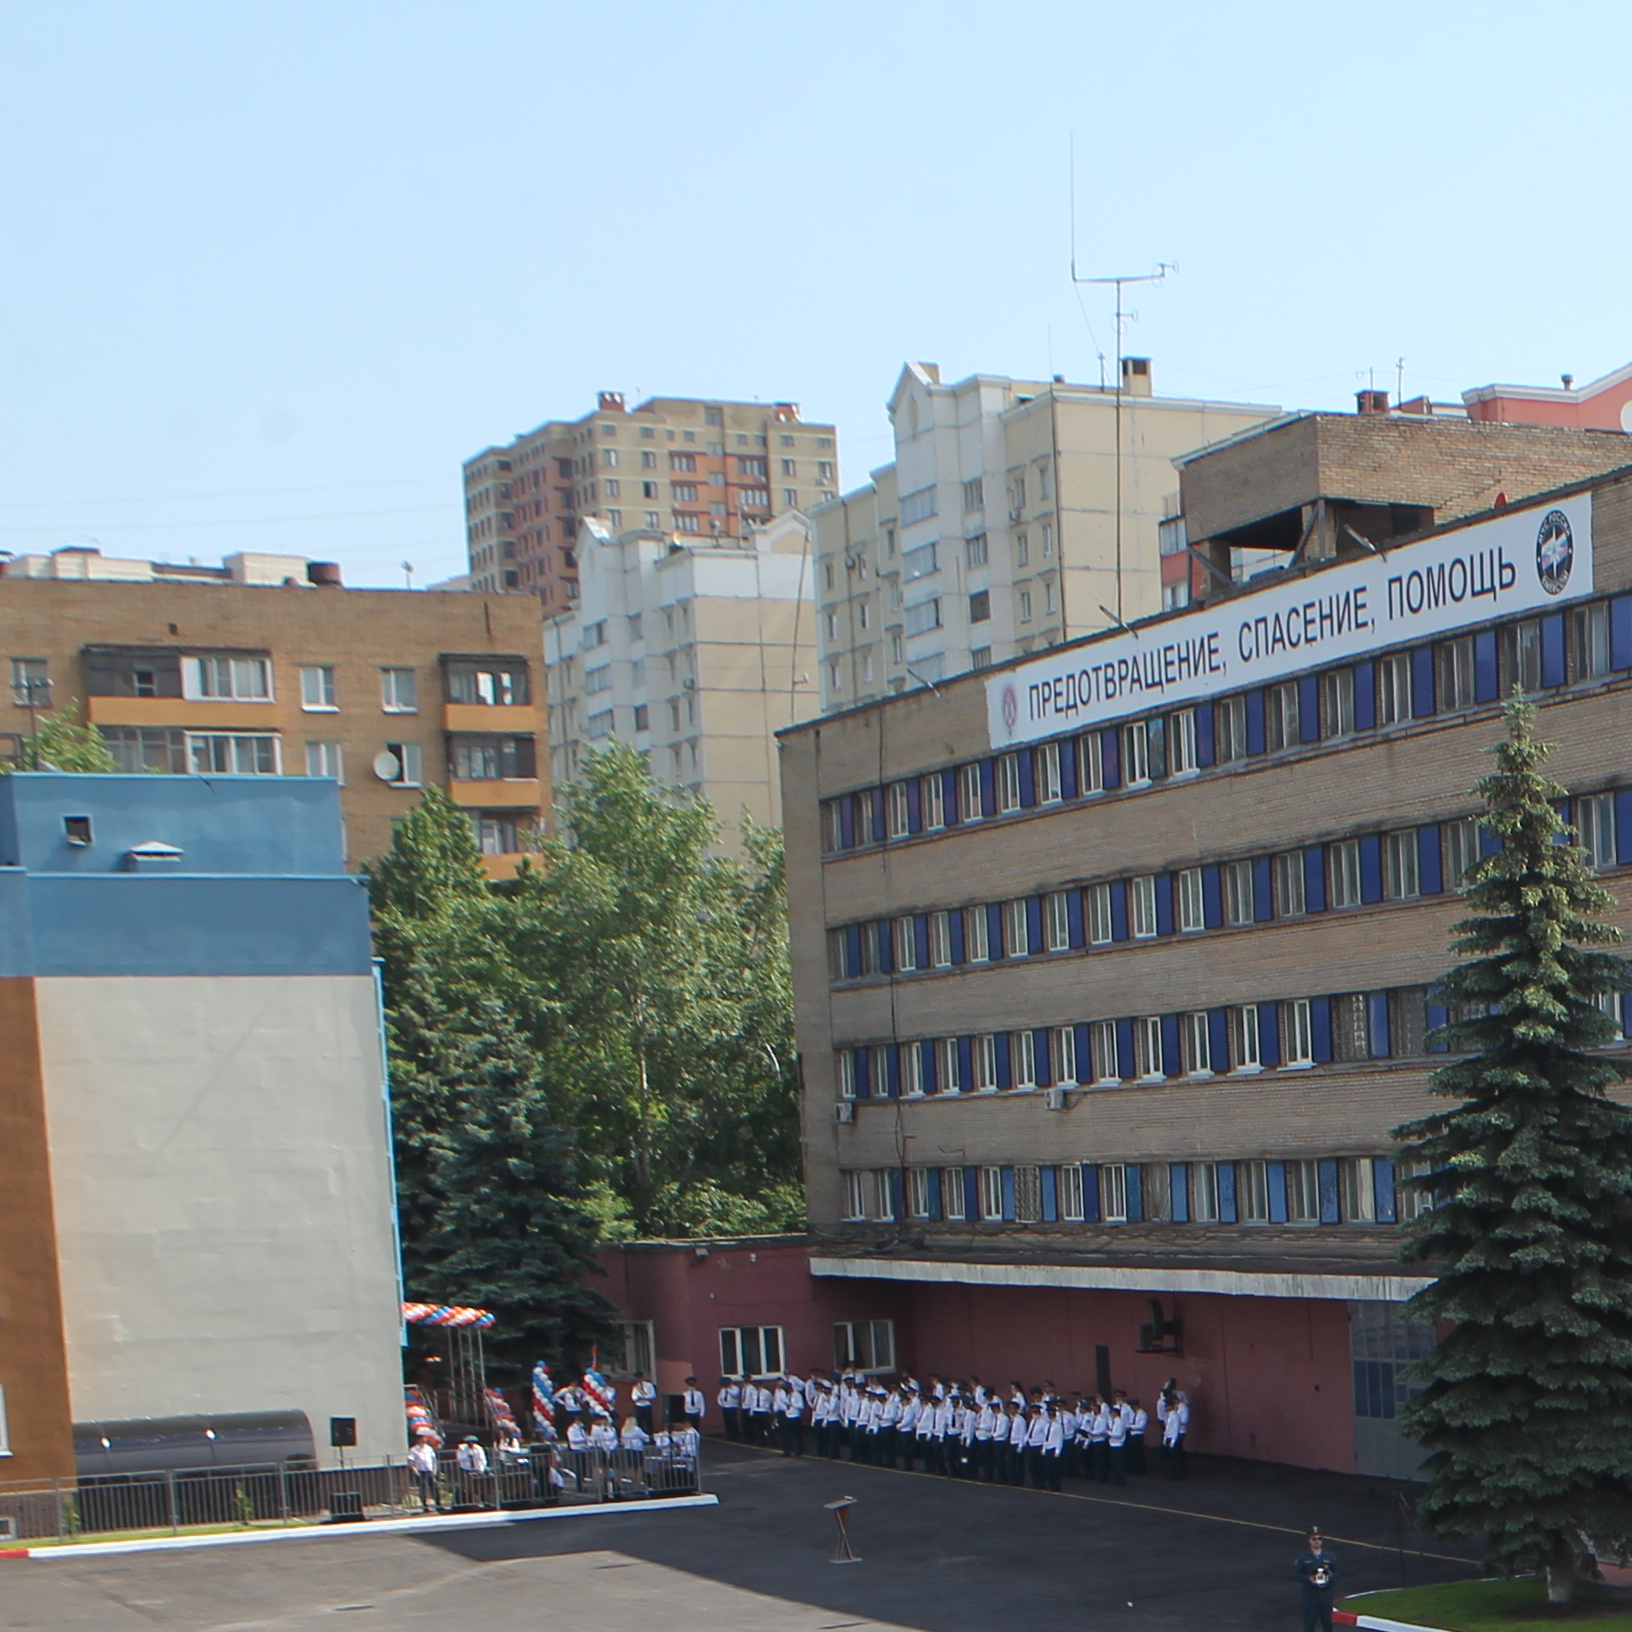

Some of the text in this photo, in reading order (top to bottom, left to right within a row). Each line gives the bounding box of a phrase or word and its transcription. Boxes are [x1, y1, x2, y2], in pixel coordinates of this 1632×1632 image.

[1029, 546, 1516, 722] ПРЕДОТВРАЩЕНИЕ, СПАСЕНИЕ, ПОМОЩЬ
